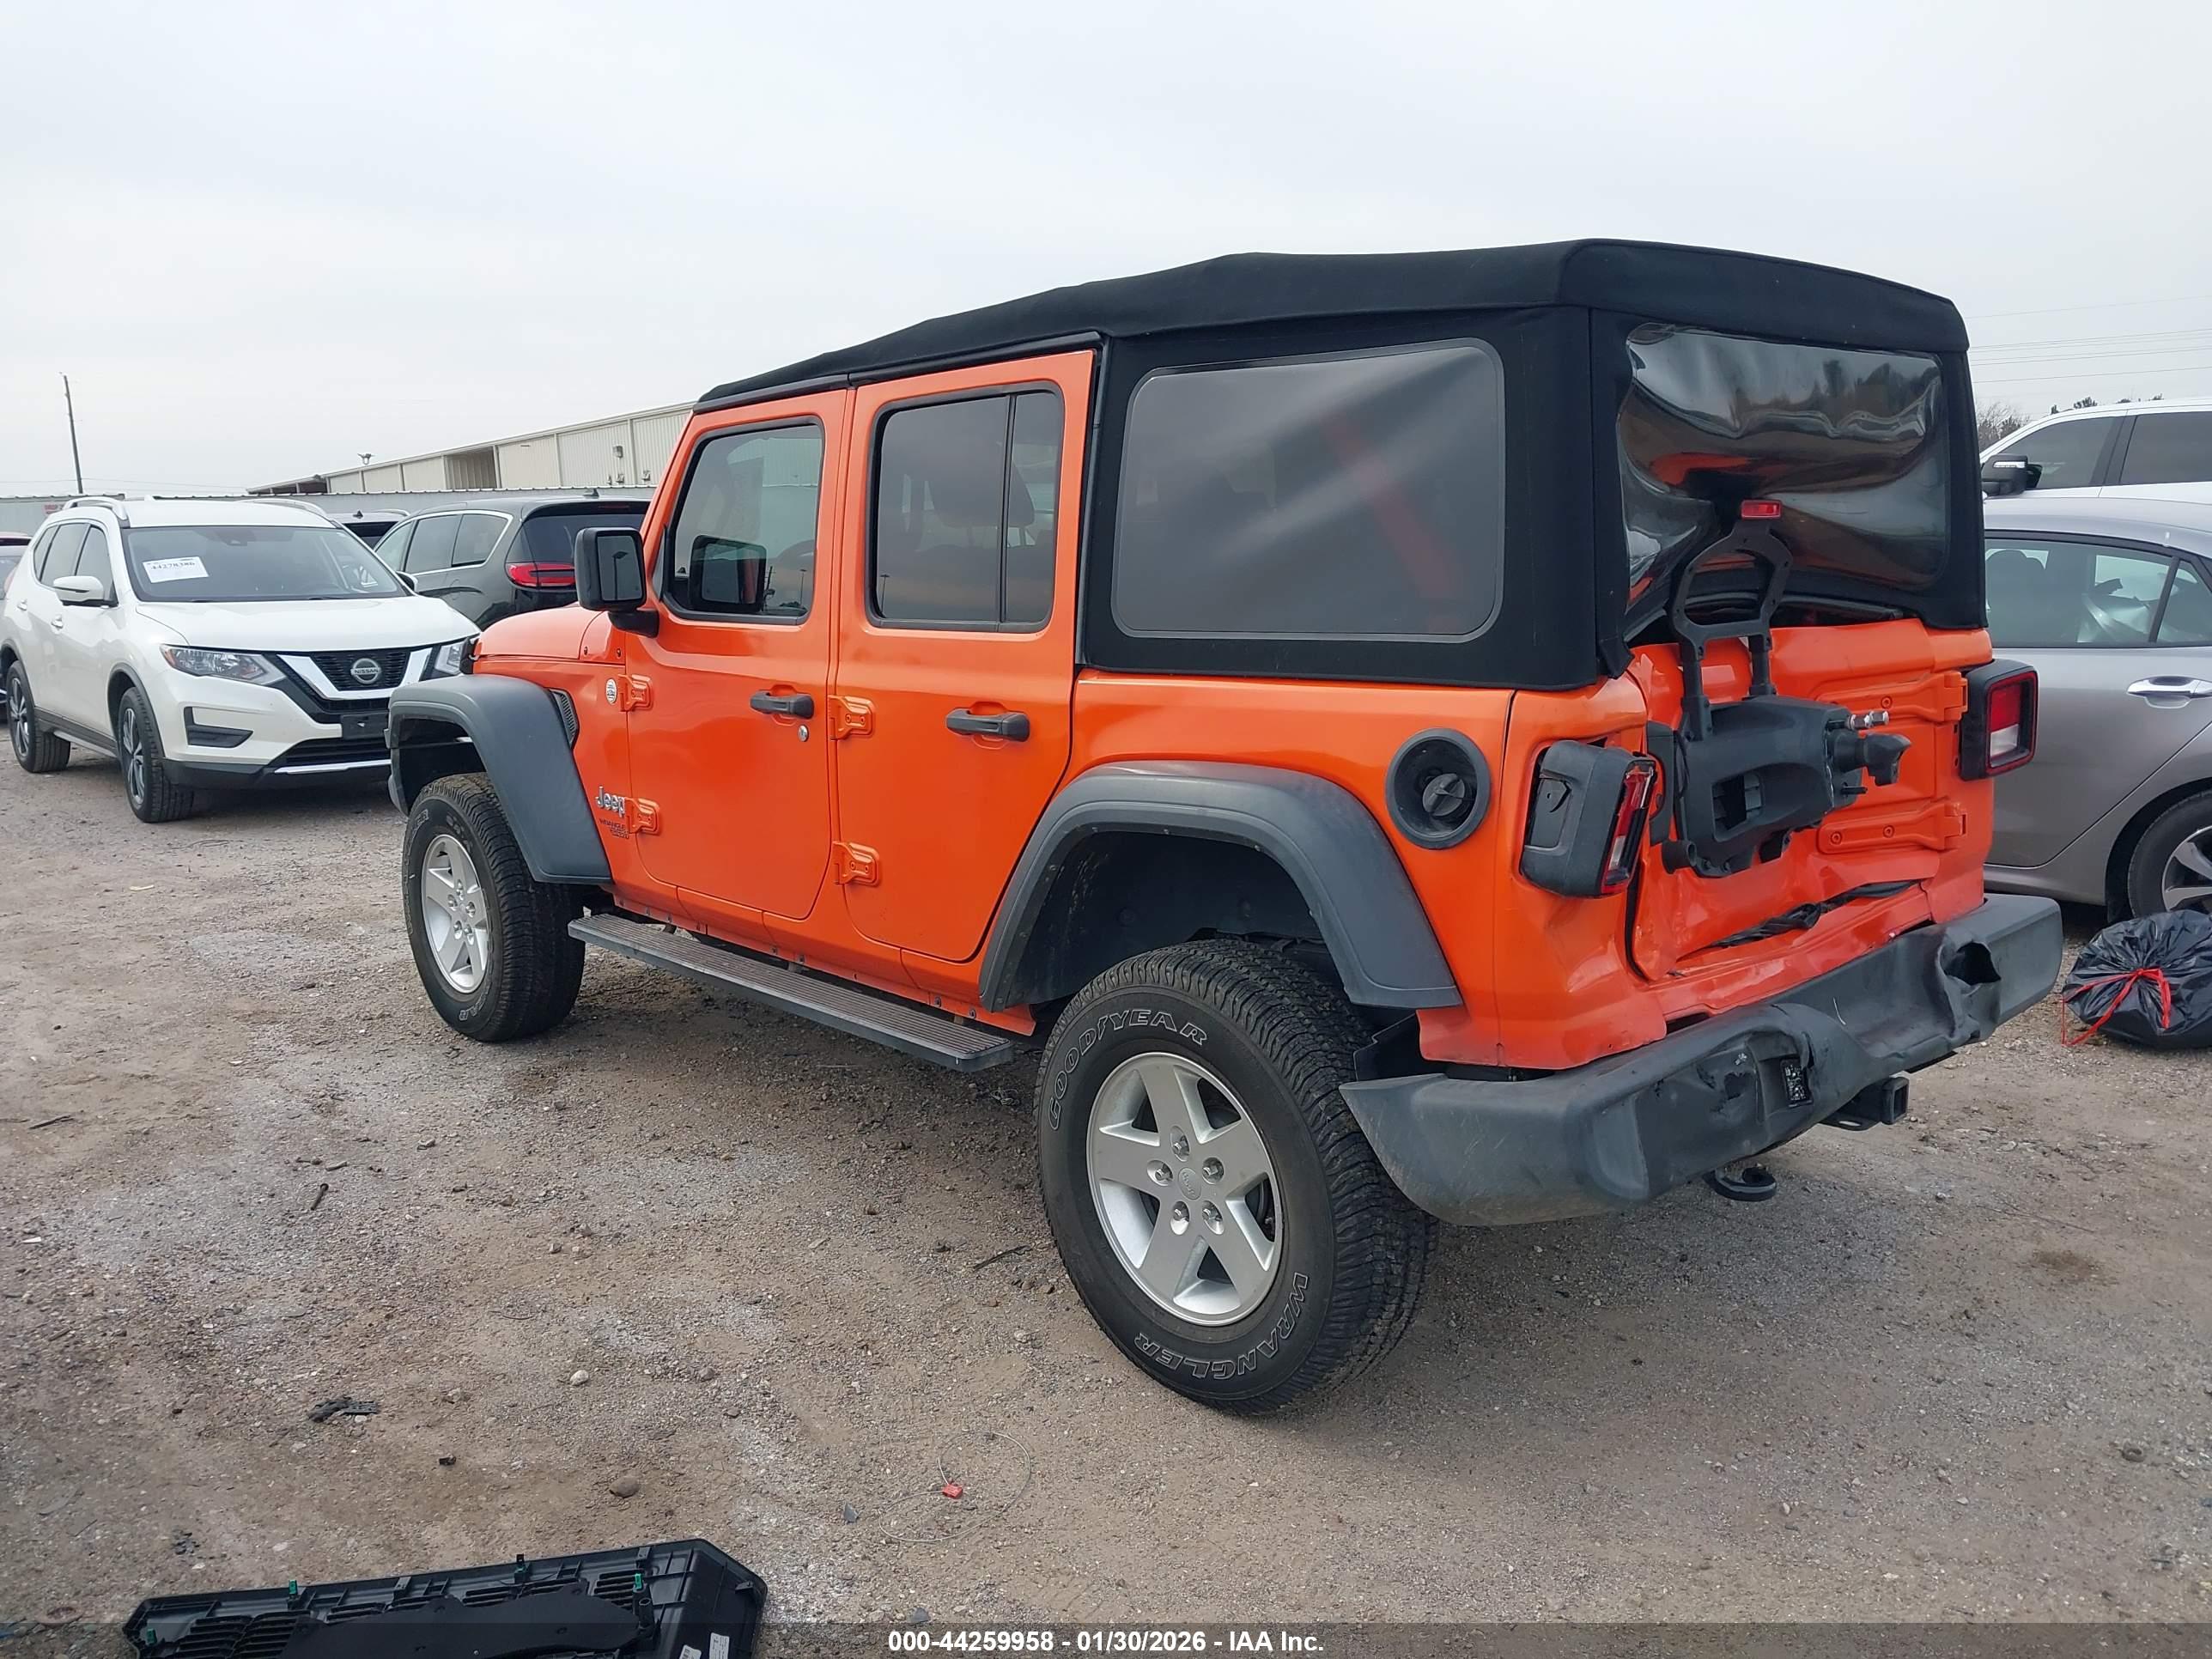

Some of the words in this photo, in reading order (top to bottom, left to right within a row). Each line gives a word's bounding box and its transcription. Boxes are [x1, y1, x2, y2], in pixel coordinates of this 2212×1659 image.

[595, 786, 626, 817] Jeep
[1048, 1009, 1208, 1131] GOODYEAR
[1133, 1271, 1310, 1380] WRANGLER
